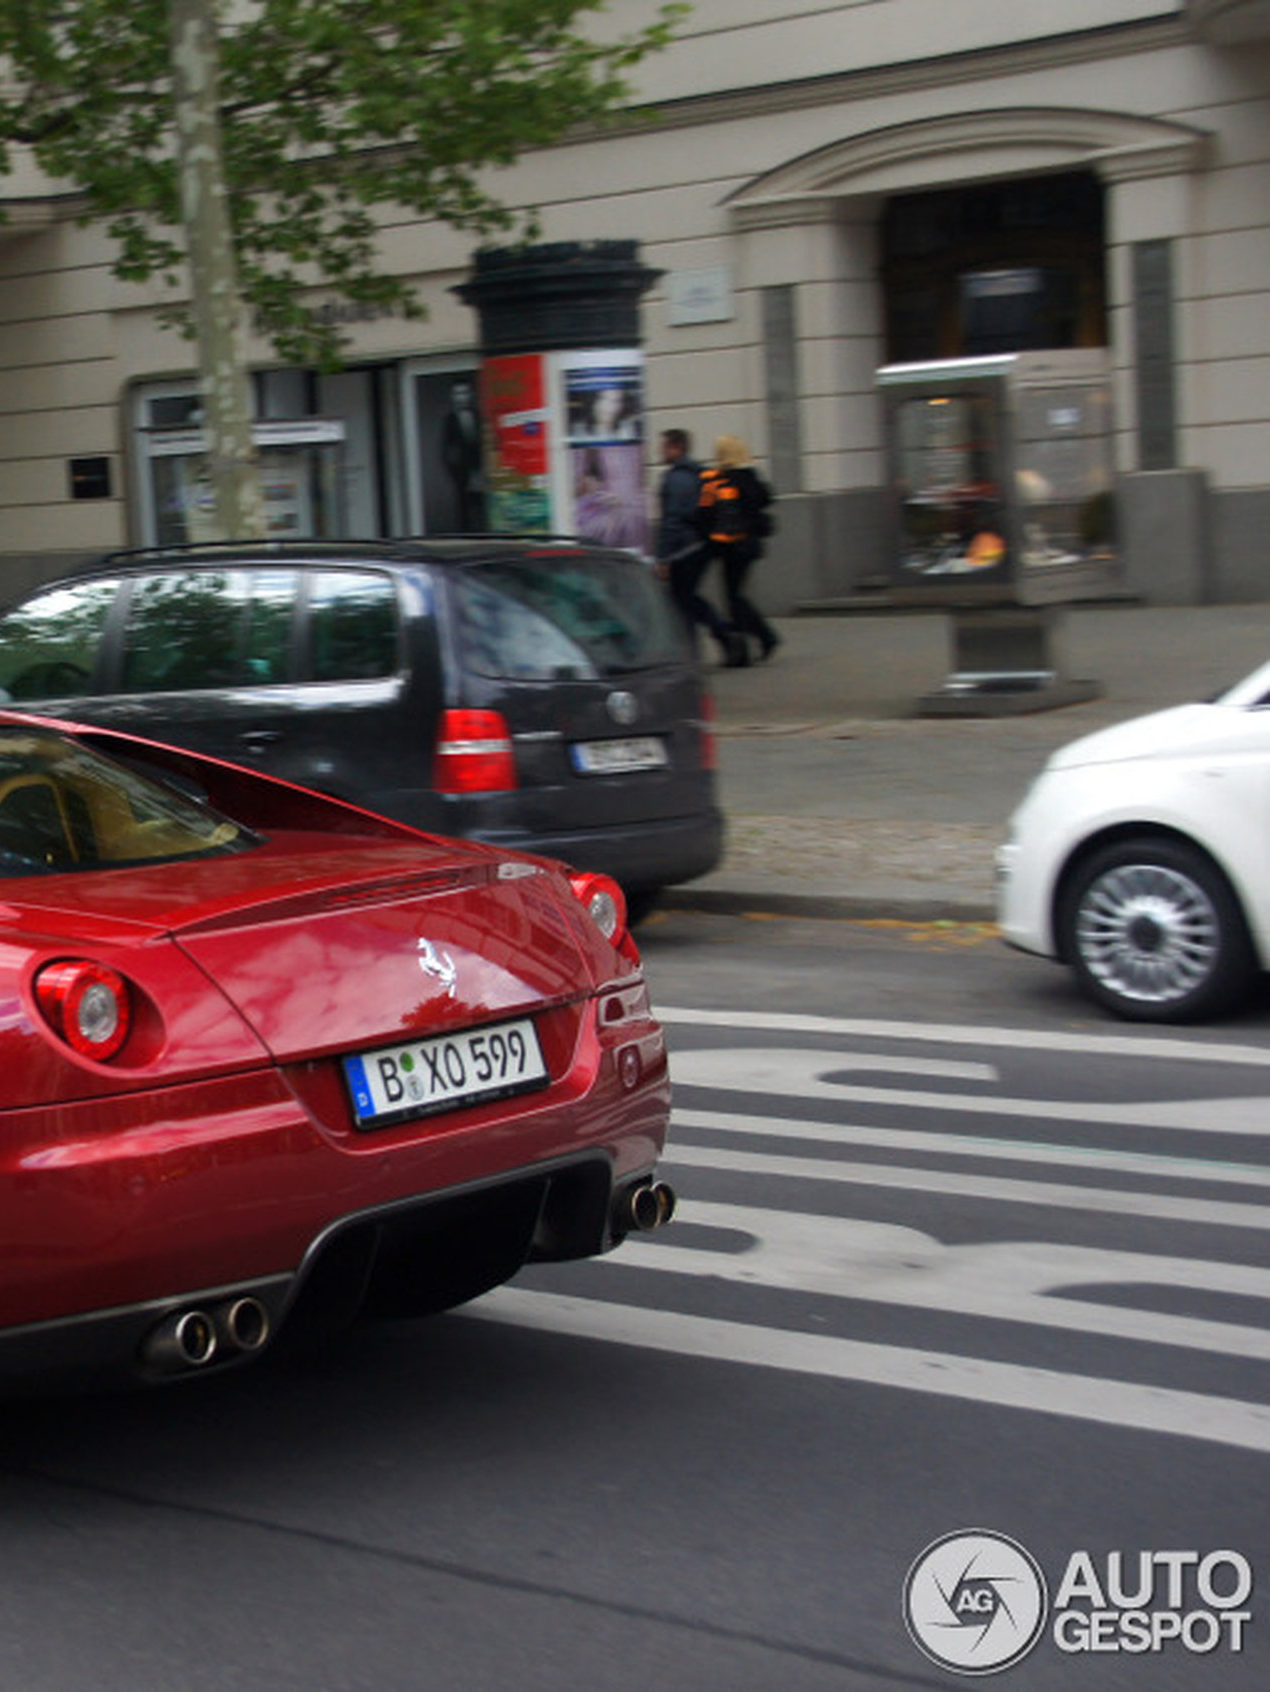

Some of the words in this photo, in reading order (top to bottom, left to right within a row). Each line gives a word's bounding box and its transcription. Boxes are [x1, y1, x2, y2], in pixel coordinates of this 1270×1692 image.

[377, 1056, 404, 1103] B
[421, 1042, 466, 1094] XO
[469, 1029, 526, 1082] 599
